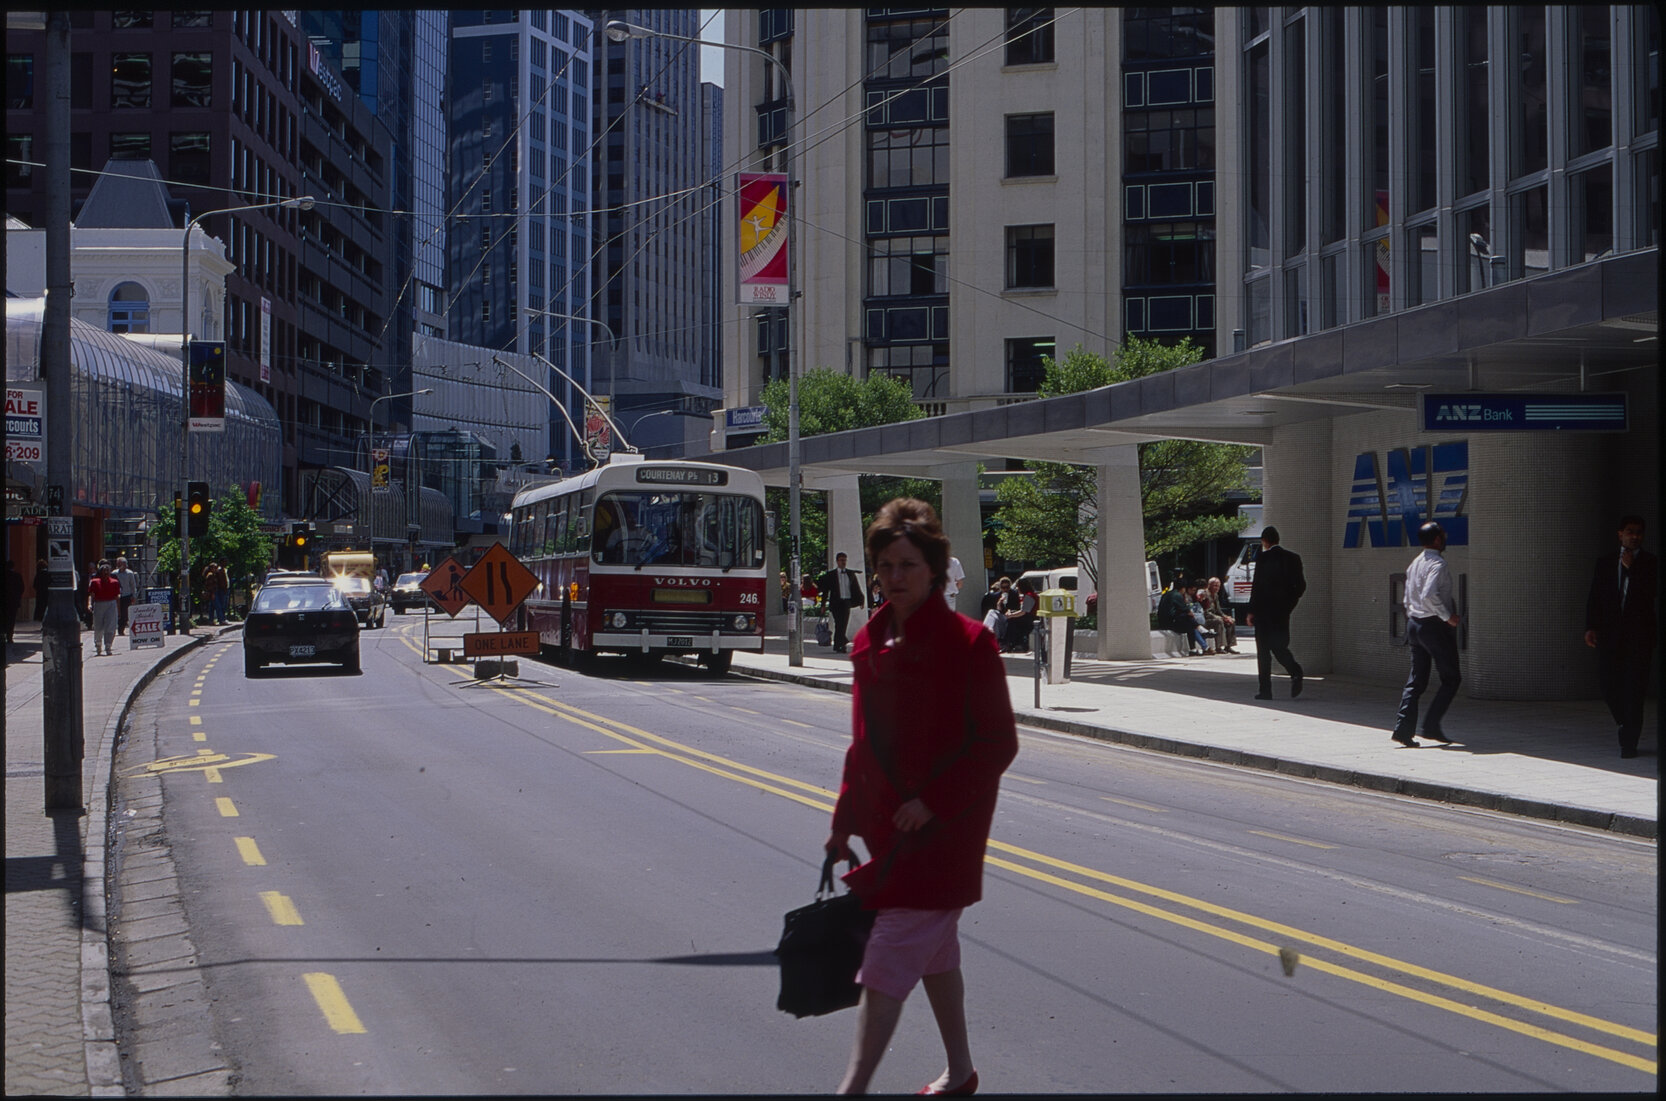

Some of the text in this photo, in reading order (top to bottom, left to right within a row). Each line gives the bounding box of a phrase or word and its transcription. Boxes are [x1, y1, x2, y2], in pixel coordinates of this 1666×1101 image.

[308, 42, 342, 102] Westpac
[8, 391, 23, 399] FOR
[1436, 405, 1513, 421] ANZ Bank
[641, 470, 685, 481] COURTENAY
[708, 472, 719, 484] 13
[1343, 440, 1469, 549] ANZ
[654, 577, 711, 586] VOLVO
[740, 593, 757, 604] 246
[135, 622, 157, 633] SALE
[475, 637, 528, 650] ONE LANE
